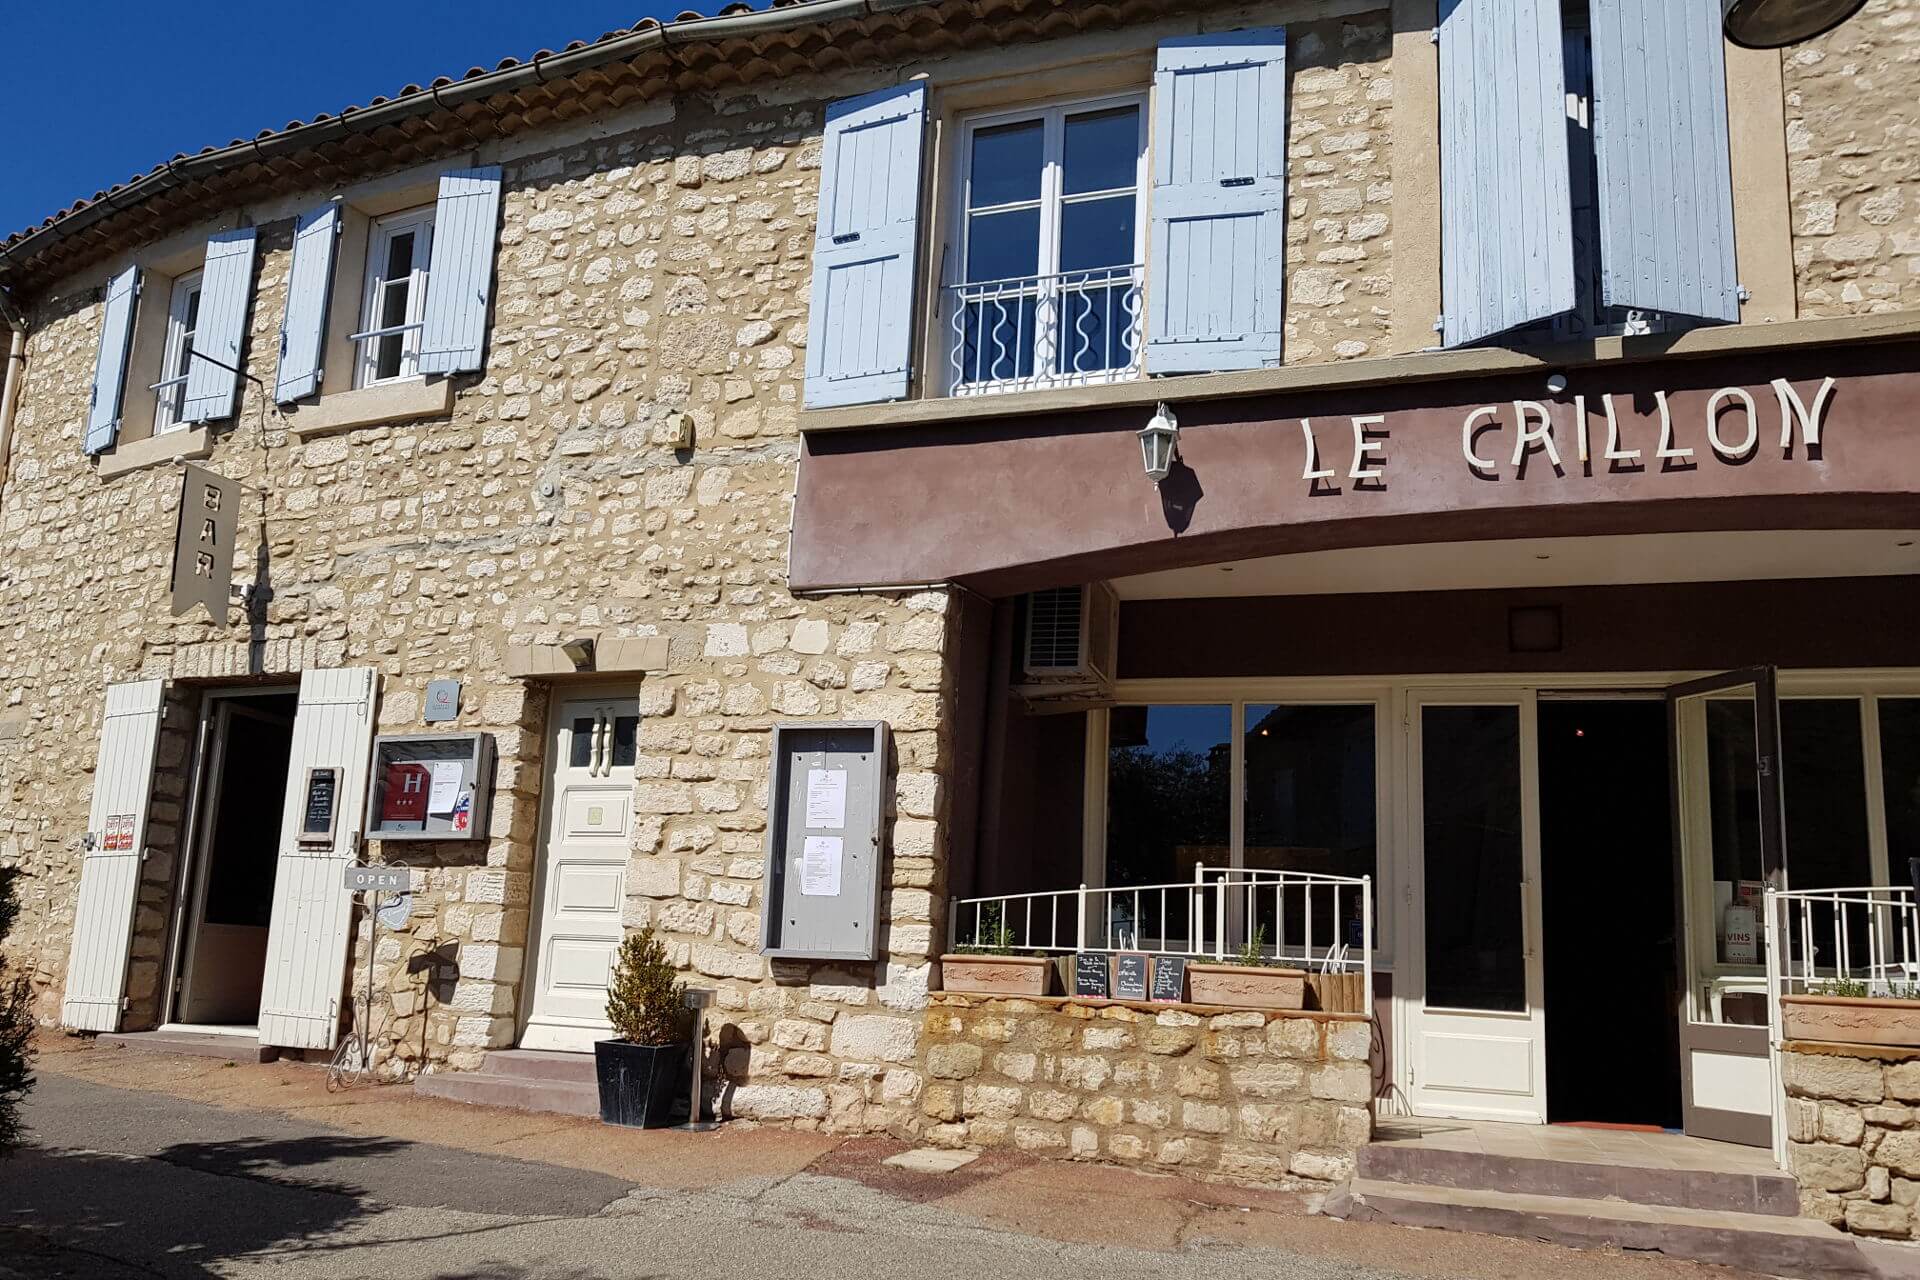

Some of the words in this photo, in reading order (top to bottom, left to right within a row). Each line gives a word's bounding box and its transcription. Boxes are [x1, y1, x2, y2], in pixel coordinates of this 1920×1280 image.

[1301, 415, 1386, 479] LE
[1462, 376, 1836, 468] CRILLON
[195, 484, 221, 580] BAR
[403, 773, 423, 793] H
[356, 874, 398, 886] OPEN
[1727, 933, 1751, 941] VINS
